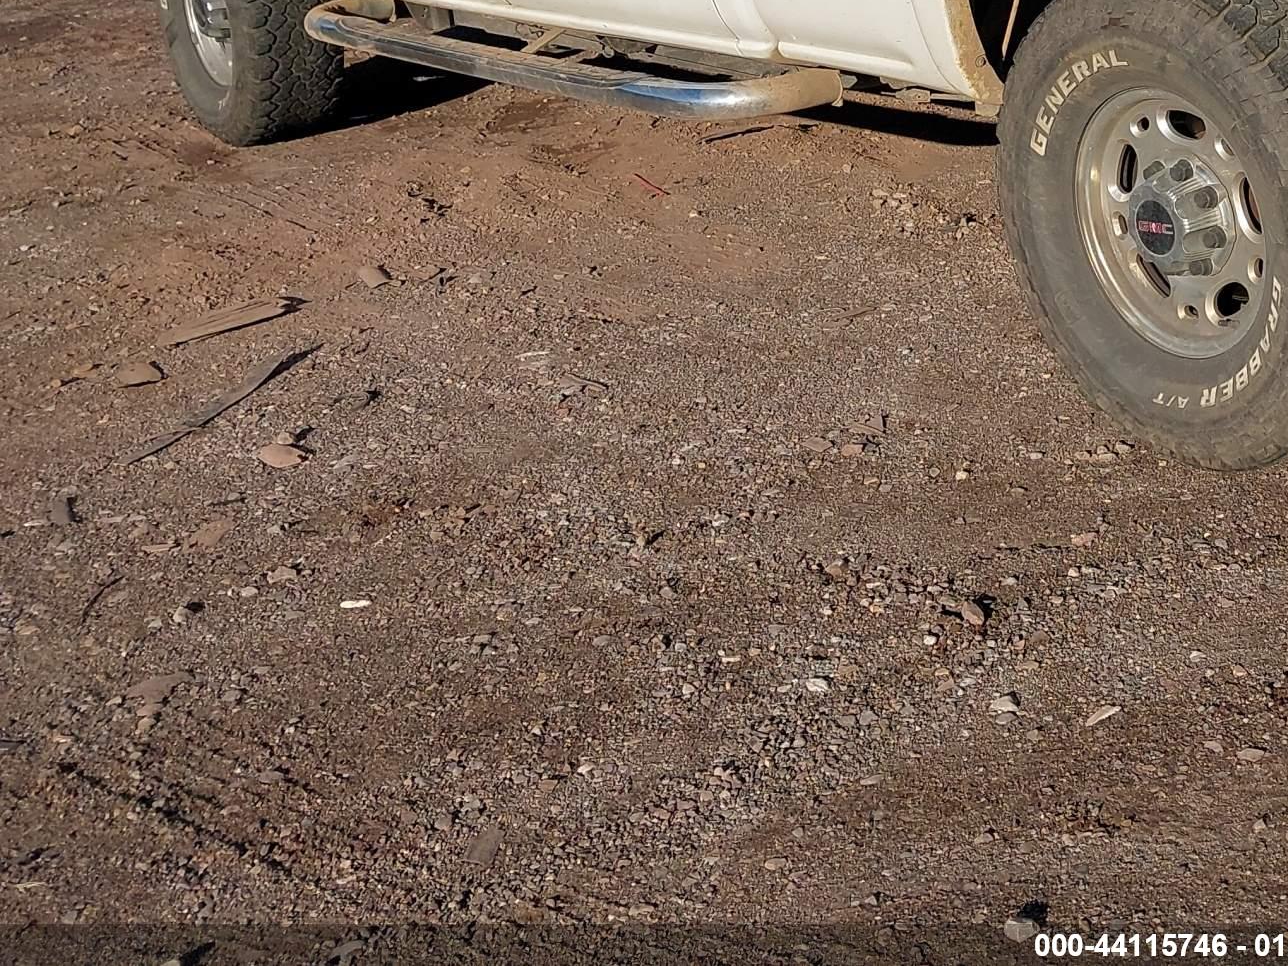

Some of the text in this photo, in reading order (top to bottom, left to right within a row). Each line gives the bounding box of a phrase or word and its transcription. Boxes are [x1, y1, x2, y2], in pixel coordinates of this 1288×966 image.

[1030, 49, 1129, 156] GENERAL
[1138, 220, 1174, 235] GMC
[1152, 275, 1282, 409] GRABBER A/T
